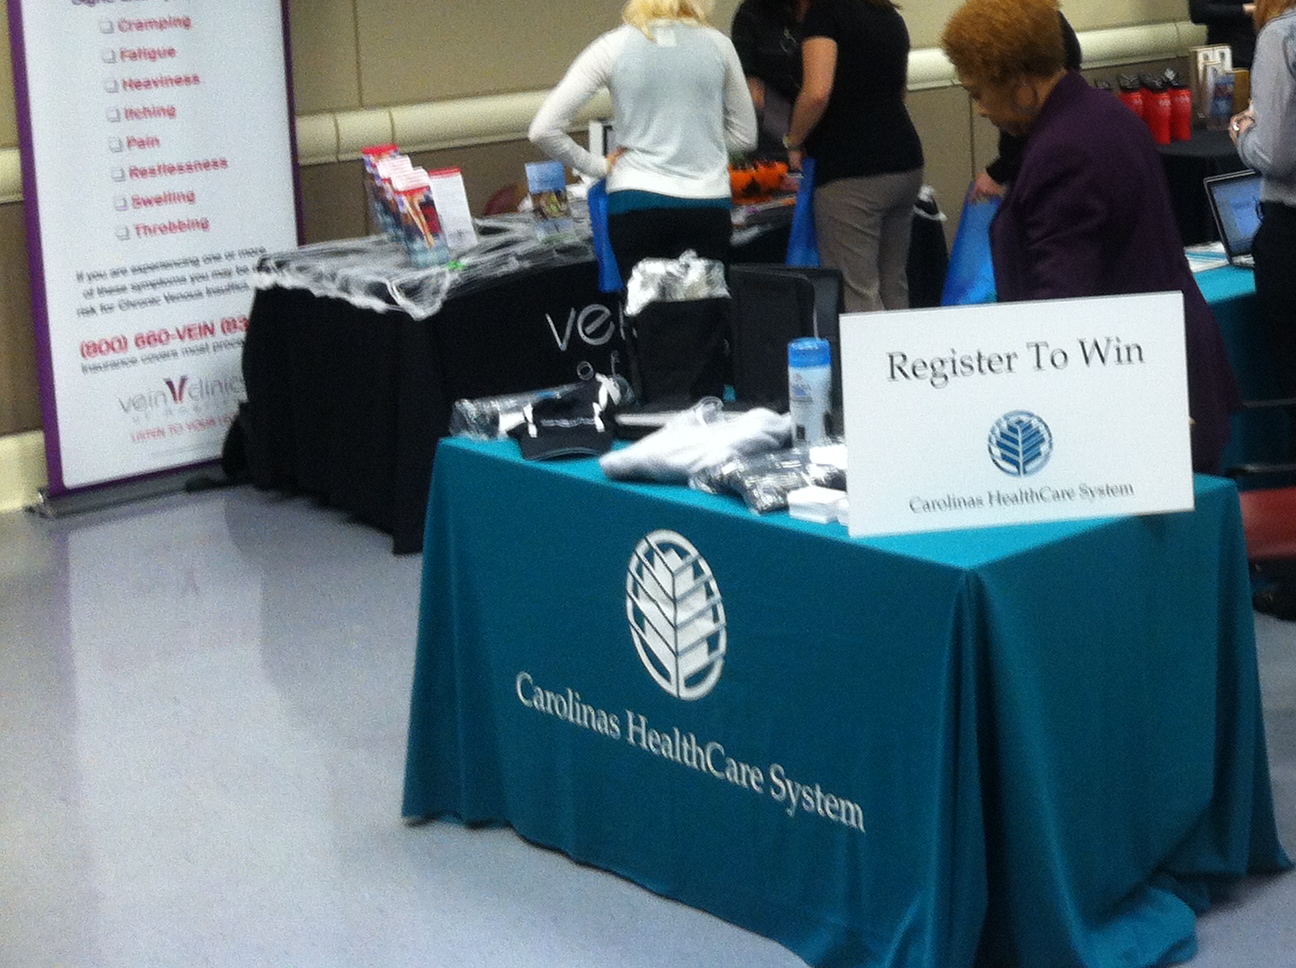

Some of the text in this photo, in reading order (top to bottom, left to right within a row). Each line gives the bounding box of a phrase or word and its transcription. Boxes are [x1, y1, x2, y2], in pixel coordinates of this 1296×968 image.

[117, 15, 193, 33] Cramping
[119, 46, 177, 62] Fatigue
[122, 73, 201, 92] Heaviness
[124, 104, 177, 121] Itching
[126, 135, 161, 150] Pain
[128, 157, 229, 180] Restlessness
[131, 191, 196, 209] Swelling
[135, 217, 211, 238] Throbbing
[544, 300, 638, 352] vei
[80, 314, 252, 360] (800) 660-VEIN (83
[886, 336, 1146, 389] Register To Win
[908, 481, 1135, 515] Carolinas HealthCare System
[515, 670, 866, 833] Carolinas HealthCare System
